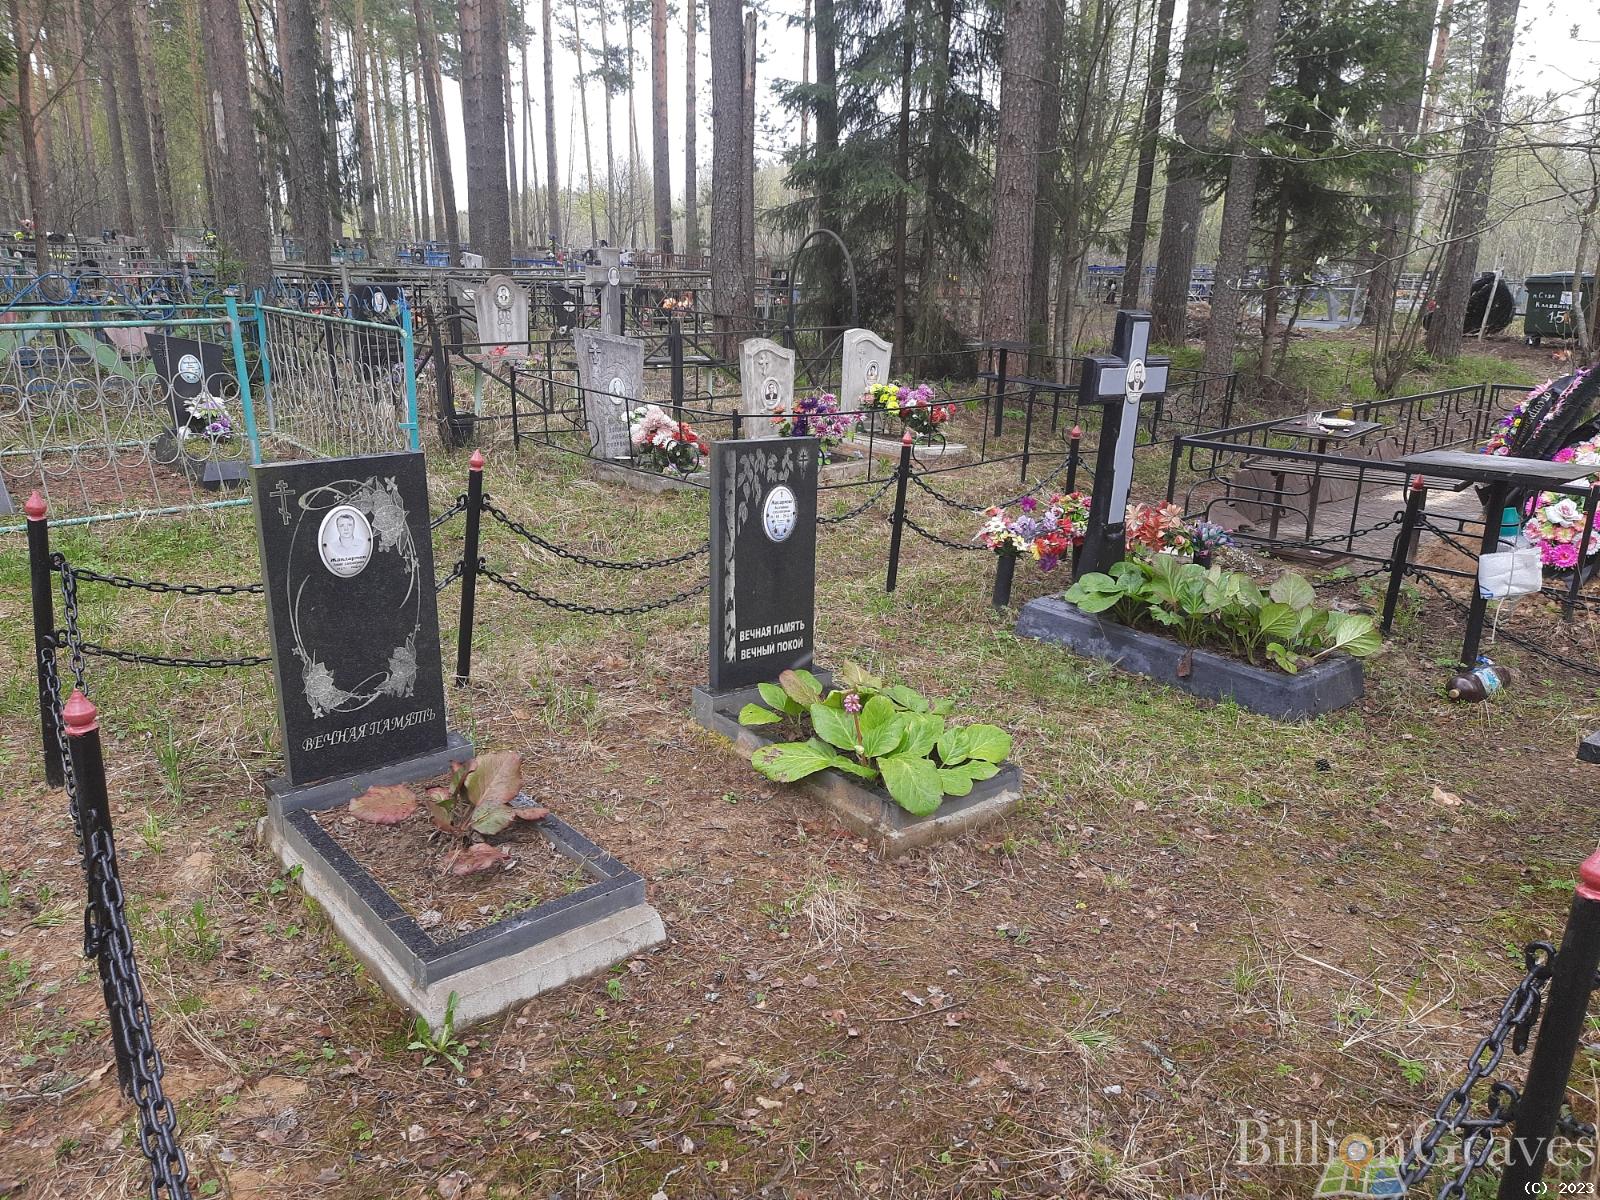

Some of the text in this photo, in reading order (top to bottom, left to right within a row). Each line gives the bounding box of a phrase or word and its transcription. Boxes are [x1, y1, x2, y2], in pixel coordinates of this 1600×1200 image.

[1548, 311, 1566, 323] 15
[740, 620, 805, 642] ВЕЧНАЯ ПАМЯТЬ
[740, 637, 804, 660] ВЕЧНЫЙ ПОКОЙ
[302, 708, 436, 751] ВЕЧНАЯ ПАМЯТЬ
